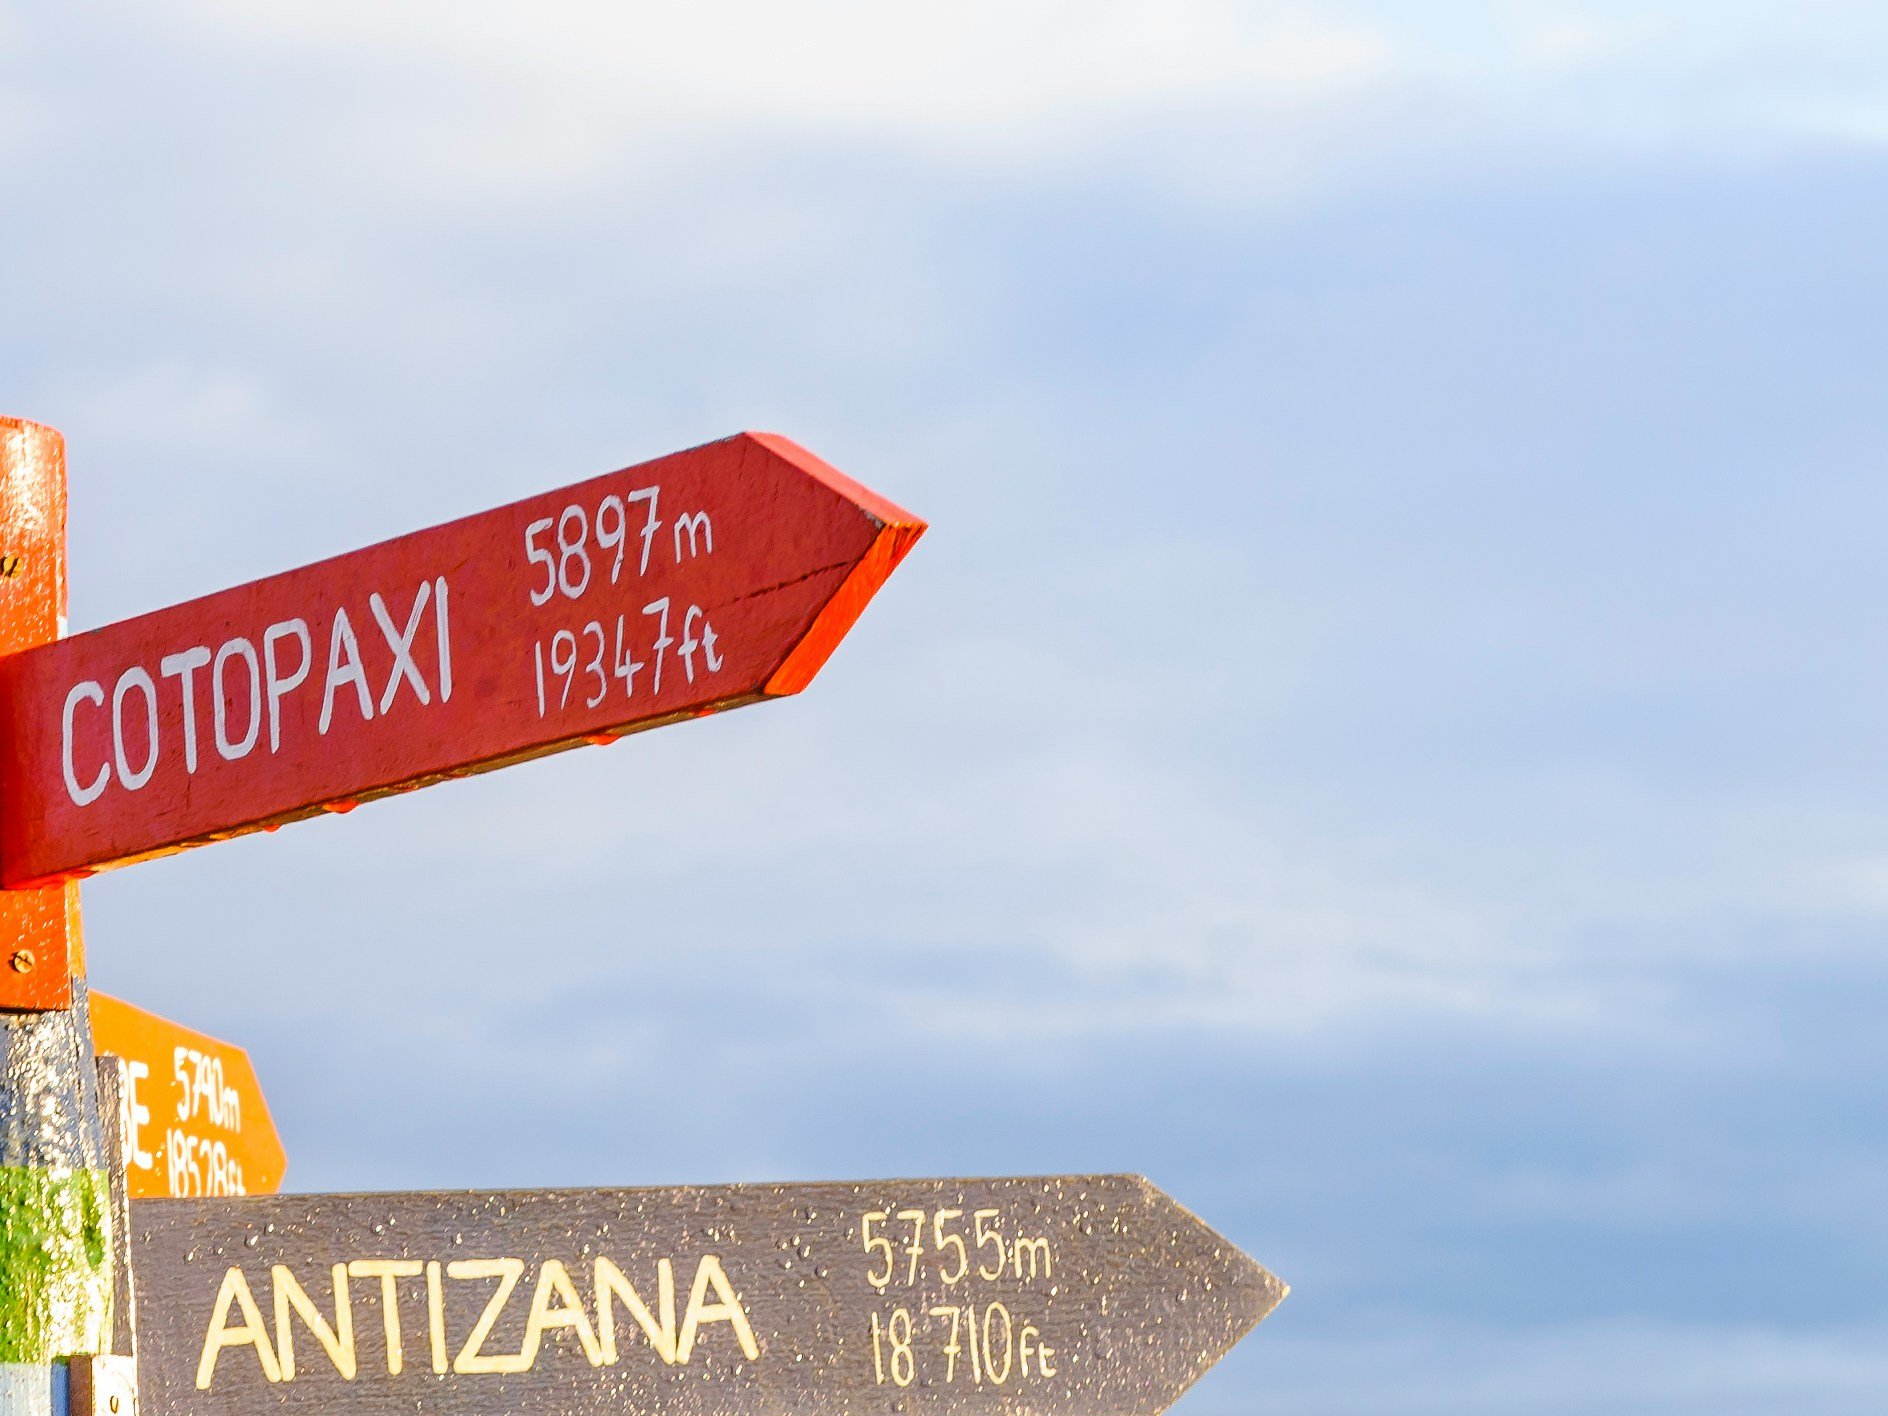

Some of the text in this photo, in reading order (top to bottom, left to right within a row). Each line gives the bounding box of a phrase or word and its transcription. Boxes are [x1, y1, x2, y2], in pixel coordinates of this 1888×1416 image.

[62, 576, 452, 807] COTOPAXI
[534, 597, 723, 718] 19347ft
[863, 1209, 1052, 1287] 5755m
[195, 1254, 760, 1390] ANTIZANA
